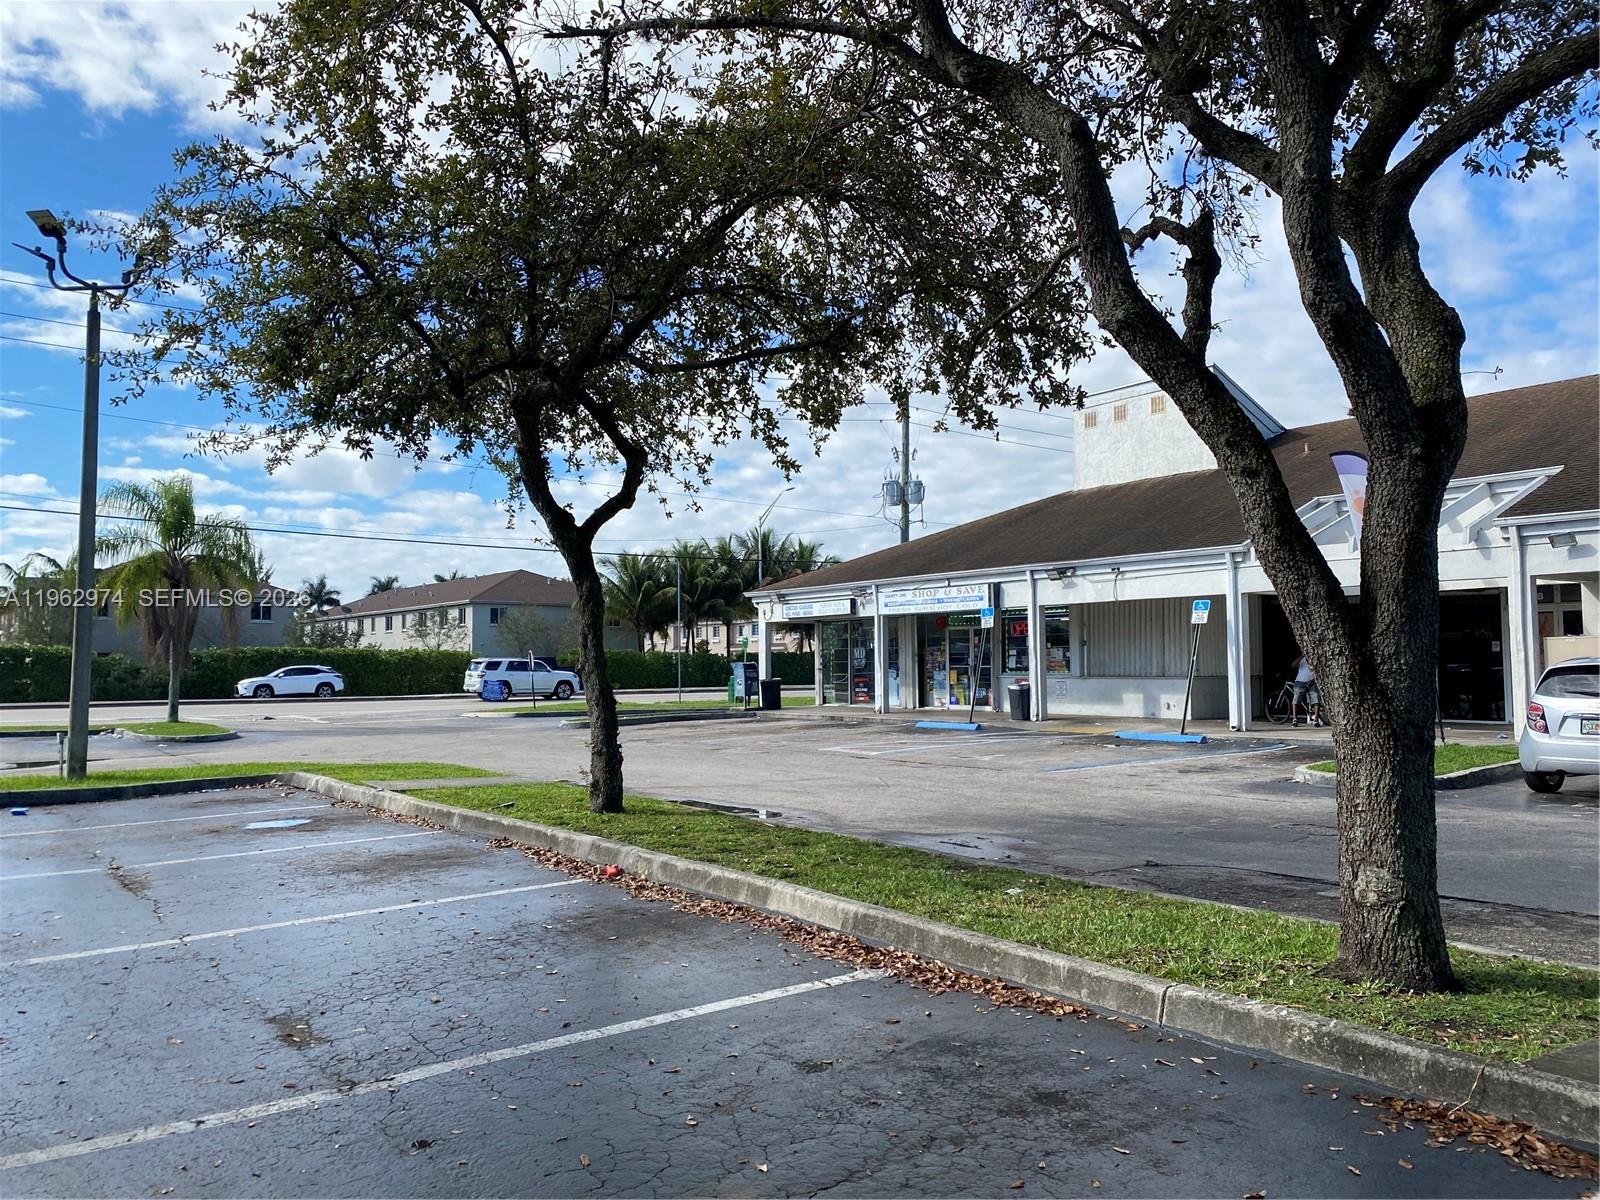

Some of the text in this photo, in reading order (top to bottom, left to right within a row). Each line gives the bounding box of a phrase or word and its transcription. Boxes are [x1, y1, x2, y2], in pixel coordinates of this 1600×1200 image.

[911, 585, 985, 599] SHOP & SAVE
[1012, 622, 1028, 634] OPE
